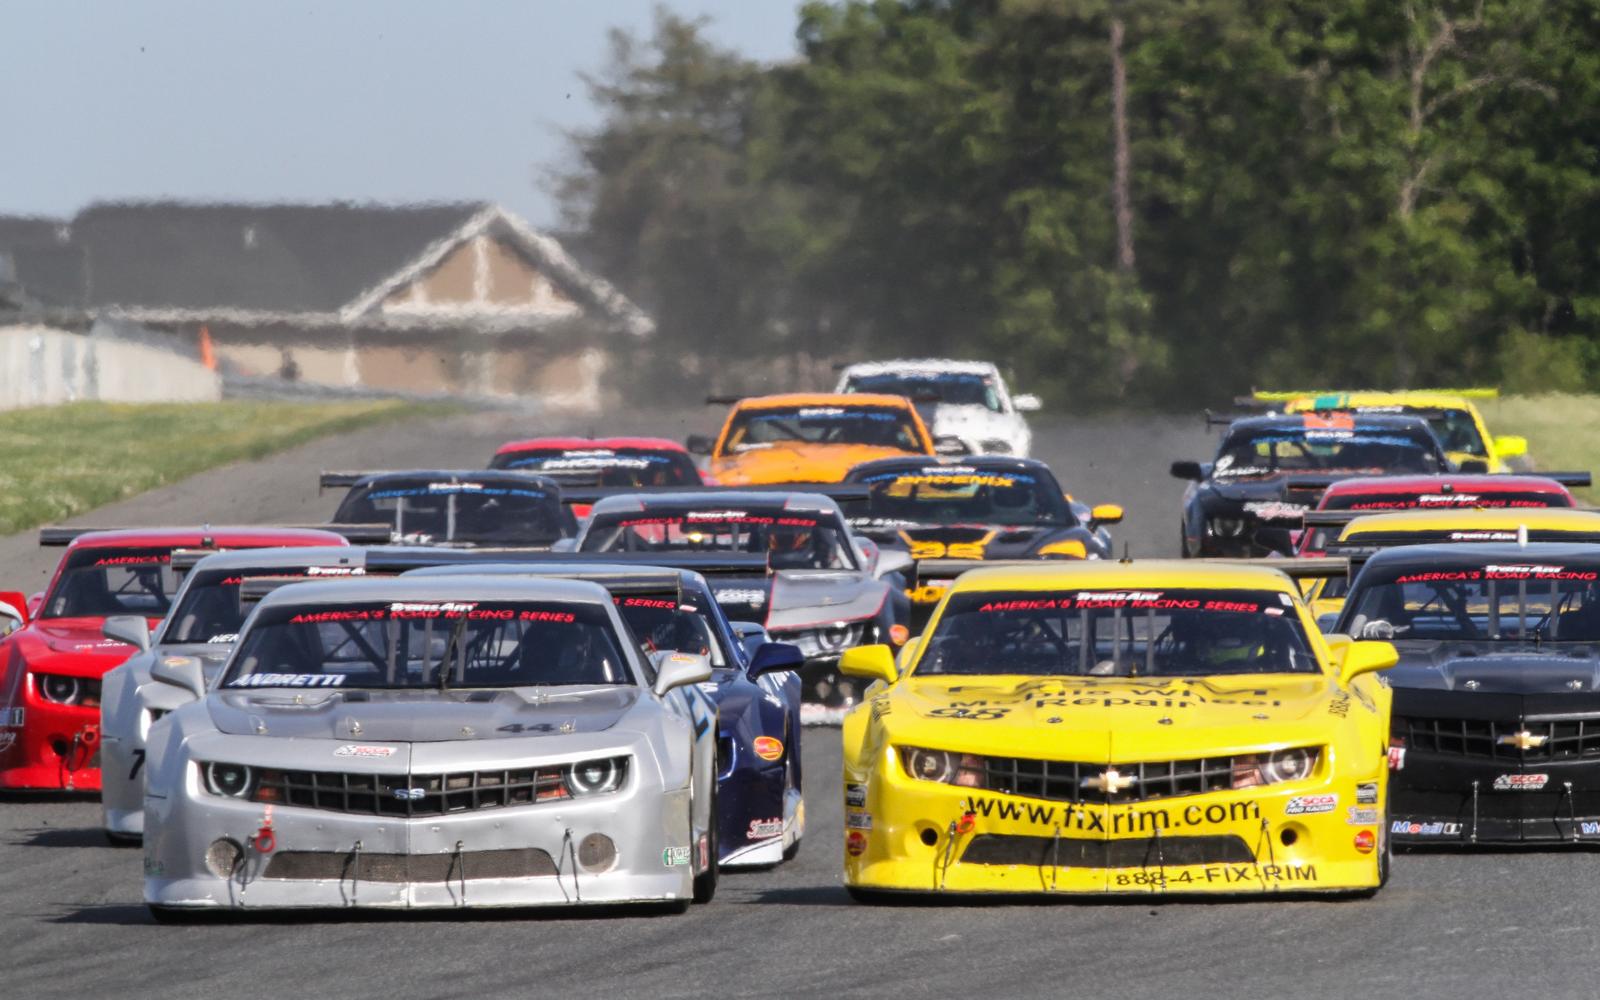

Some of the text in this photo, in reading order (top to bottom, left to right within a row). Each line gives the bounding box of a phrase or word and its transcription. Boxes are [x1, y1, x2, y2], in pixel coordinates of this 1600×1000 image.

[896, 475, 1016, 487] PHOENIX
[95, 554, 170, 568] AMERICA'S
[1395, 571, 1598, 584] AMERICA'S ROAD RACING
[624, 598, 676, 609] SERIES
[979, 600, 1259, 613] AMERICA'S ROAD RACING SERIES
[289, 609, 385, 624] AMERICA'S
[390, 609, 440, 619] ROAD
[519, 611, 575, 623] SERIES
[228, 673, 346, 686] ANDRETTI
[1035, 697, 1197, 708] Repair
[1302, 796, 1336, 806] SCCA
[967, 796, 1261, 833] www.fixrim.com
[1391, 820, 1443, 835] Mobil
[1116, 864, 1317, 886] 888-4-FIX-RIM
